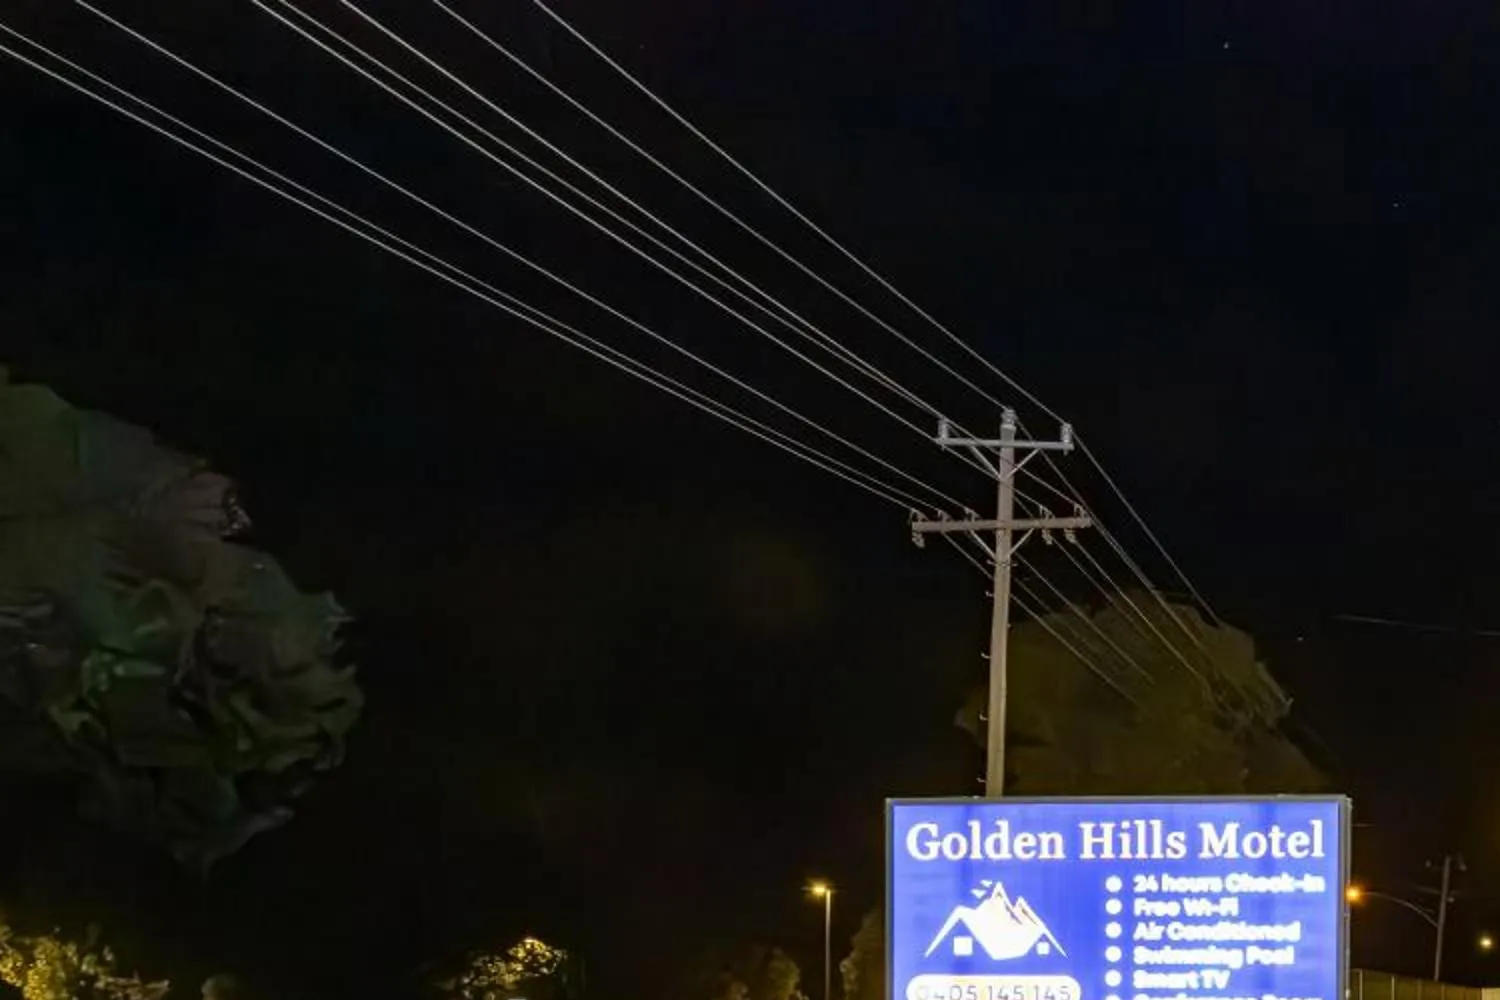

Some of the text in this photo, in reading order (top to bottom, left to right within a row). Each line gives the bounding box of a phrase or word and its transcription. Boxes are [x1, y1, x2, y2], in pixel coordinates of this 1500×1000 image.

[906, 818, 1325, 861] Golden Hills Motel
[1133, 874, 1159, 893] 24
[1162, 873, 1222, 893] hours
[1133, 897, 1181, 916] Free
[1133, 921, 1301, 941] Air Conditioned
[1133, 945, 1295, 969] Swimming Pool
[1133, 969, 1231, 989] Smart TV
